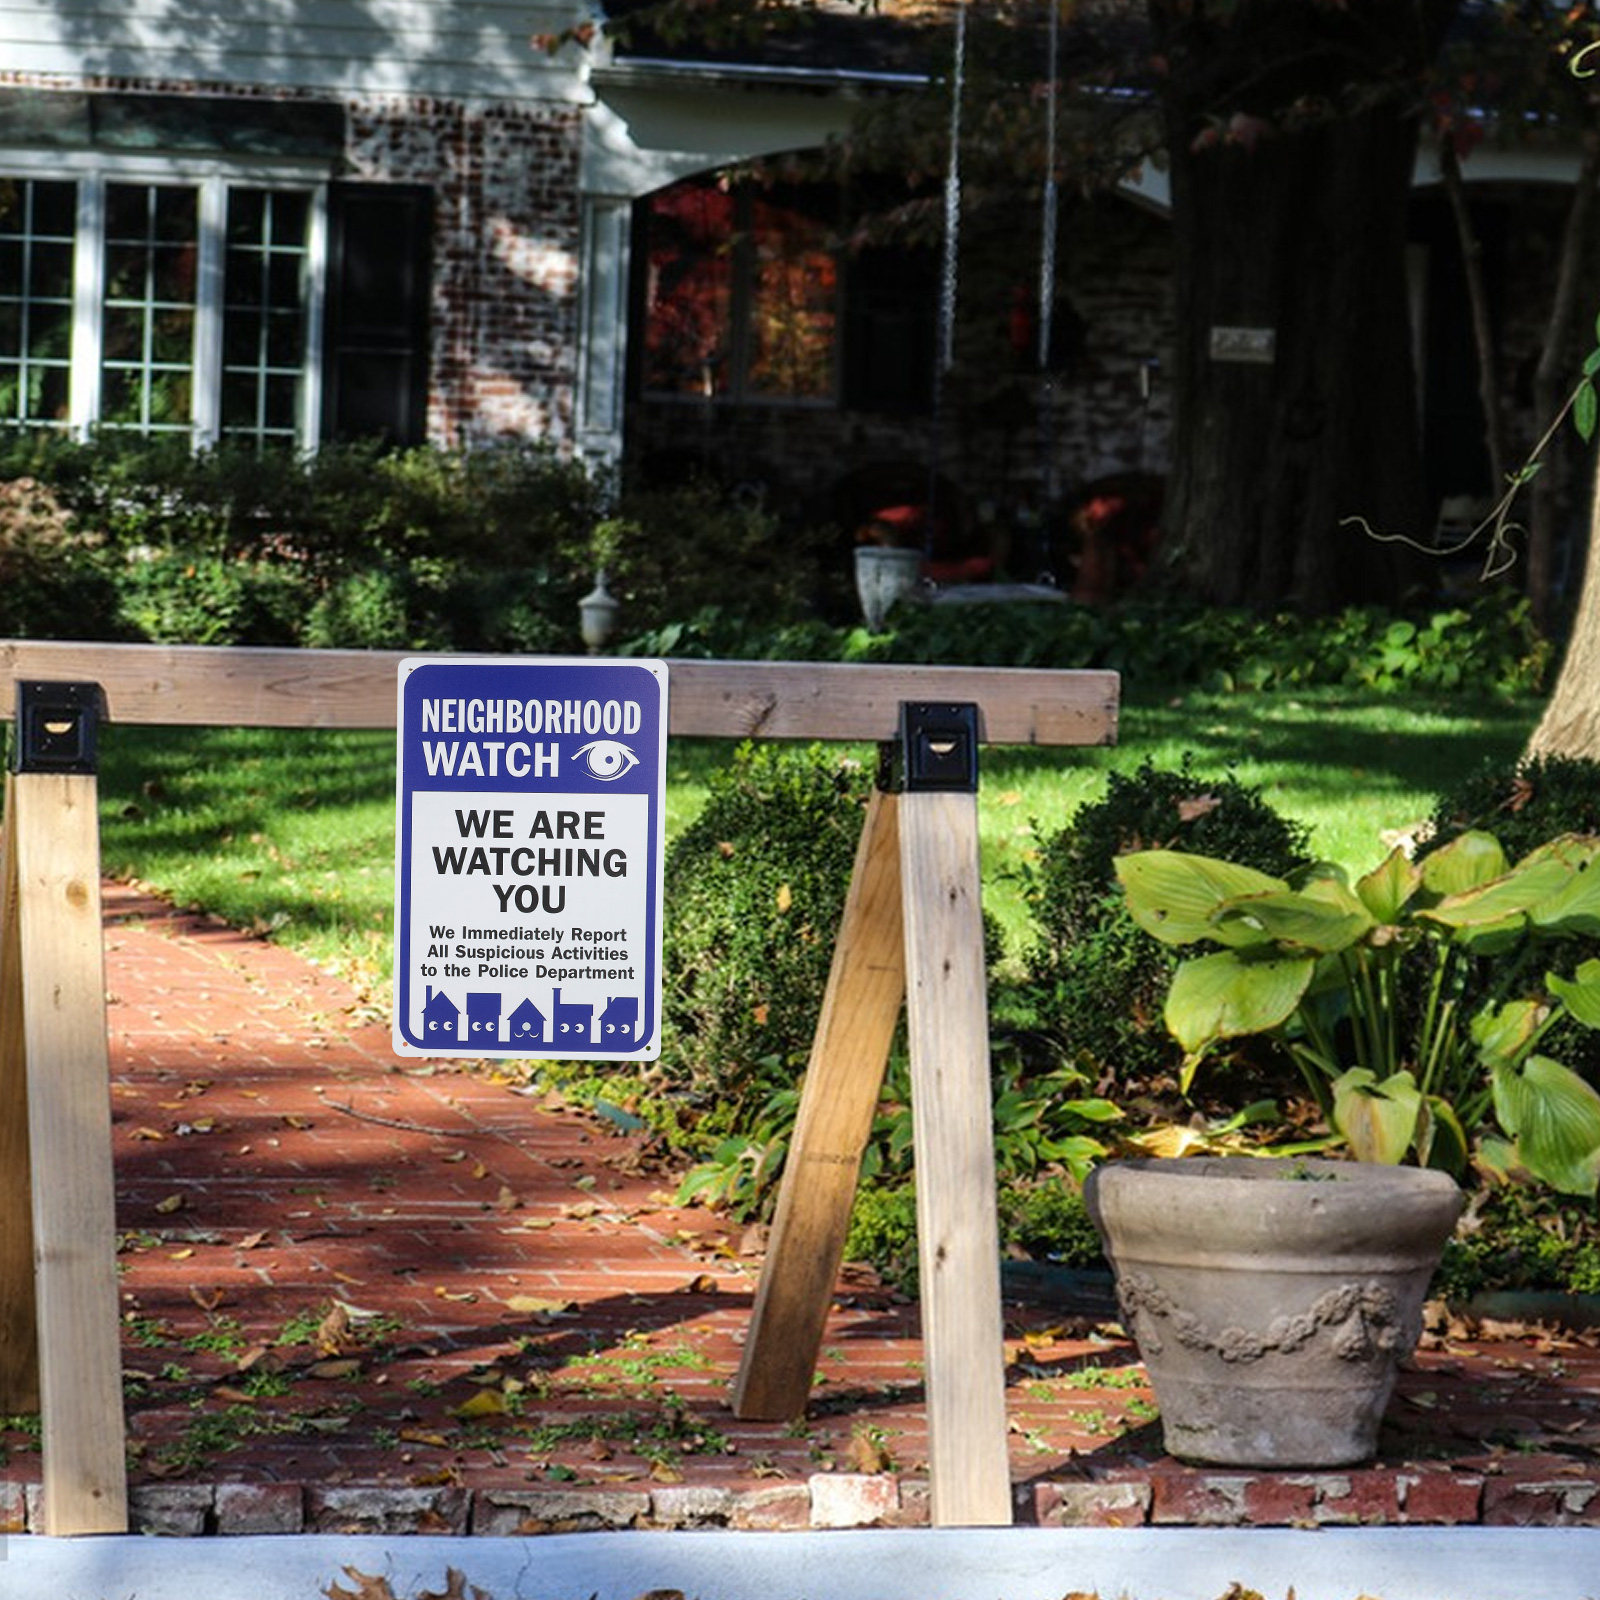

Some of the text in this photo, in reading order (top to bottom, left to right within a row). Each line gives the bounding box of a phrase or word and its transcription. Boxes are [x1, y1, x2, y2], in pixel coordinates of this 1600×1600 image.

[421, 698, 642, 735] NEIGHBORHOOD
[421, 741, 560, 778] WATCH
[454, 809, 606, 840] WE ARE
[431, 846, 627, 878] WATCHING
[492, 884, 566, 914] YOU
[428, 925, 627, 945] We Immediately Report
[426, 944, 629, 962] All Suspicious Activities
[420, 963, 635, 982] to the Police Department
